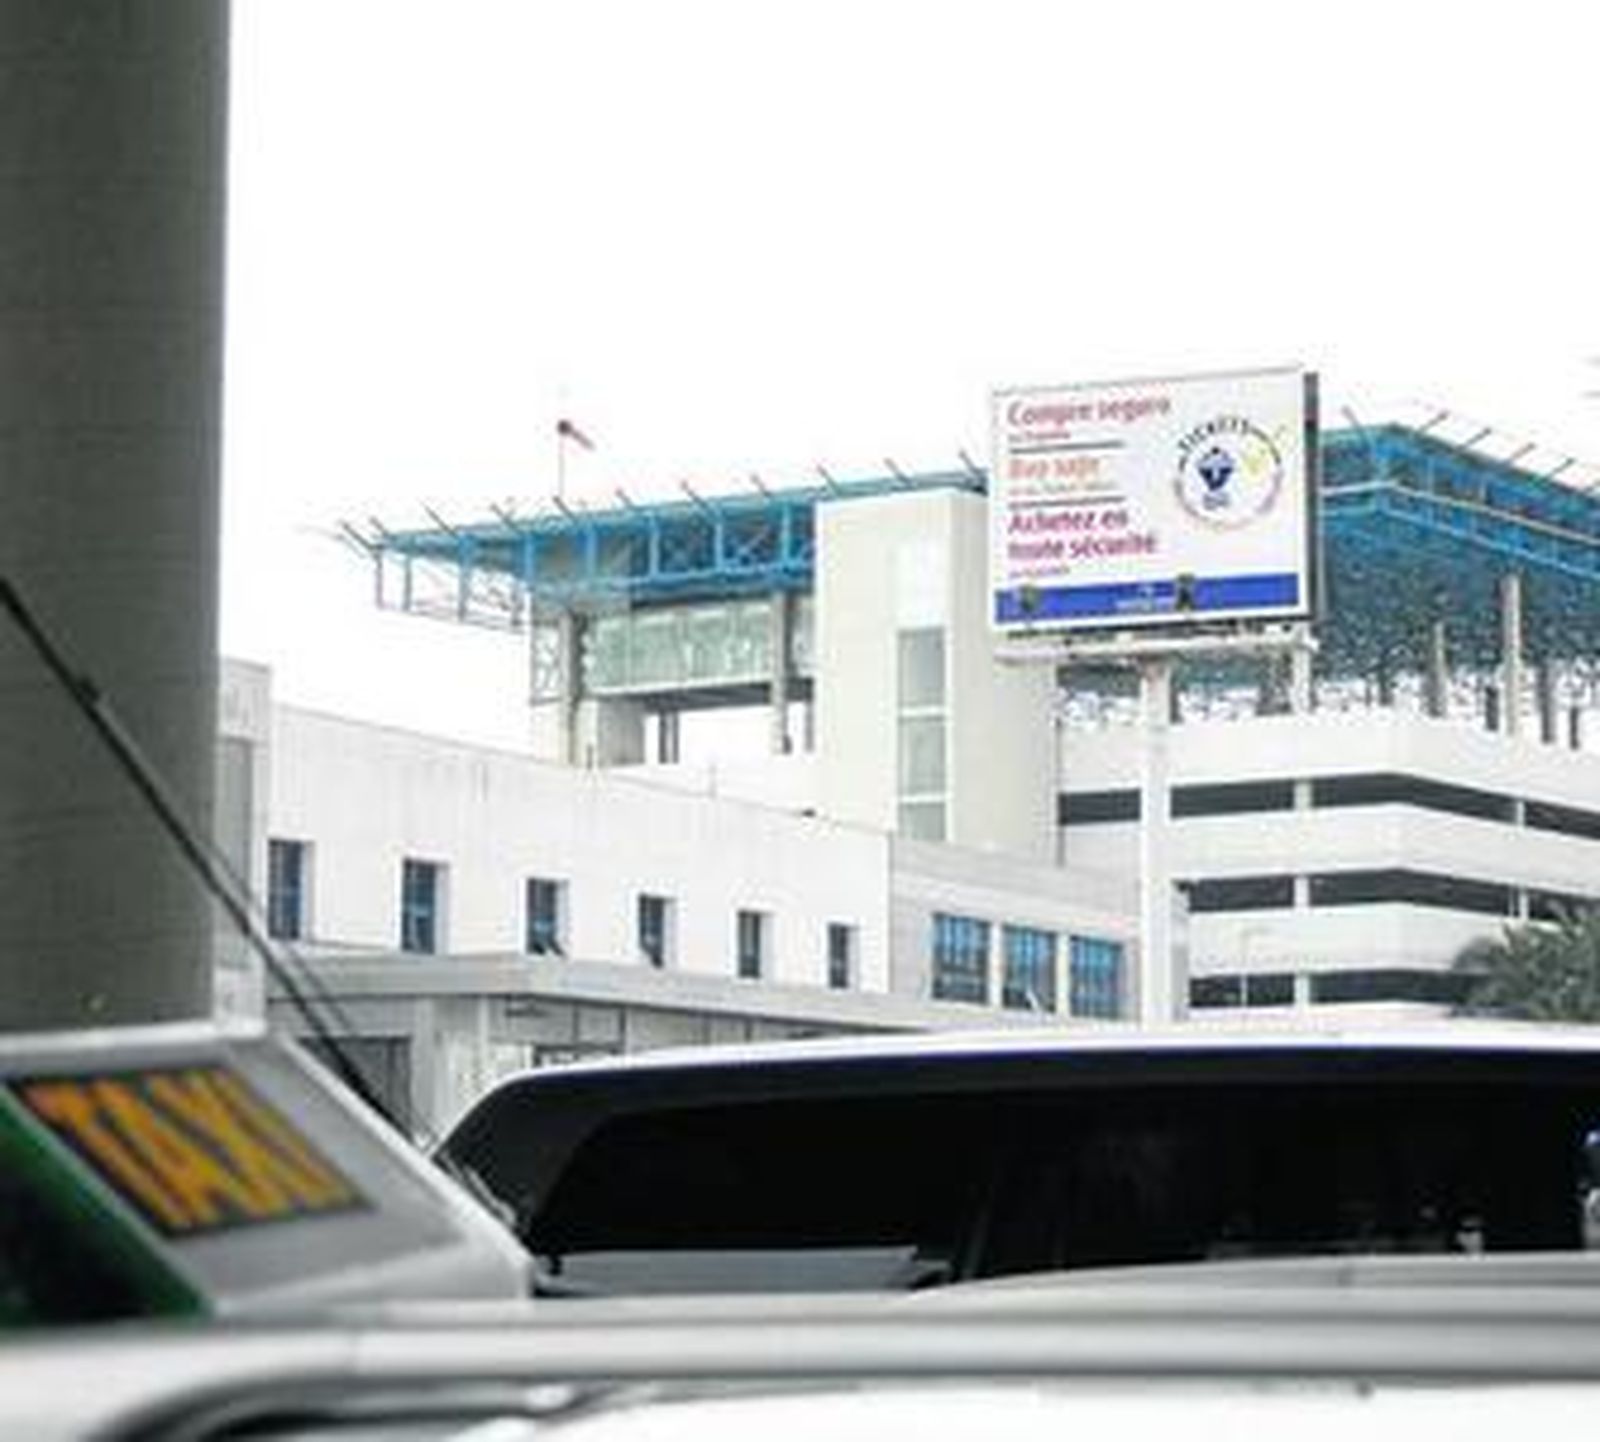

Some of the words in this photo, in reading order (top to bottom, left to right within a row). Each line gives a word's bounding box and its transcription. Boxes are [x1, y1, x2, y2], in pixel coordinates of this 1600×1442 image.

[1007, 399, 1092, 426] Compre
[1006, 511, 1096, 533] Achetez
[18, 1066, 366, 1232] TAXI
